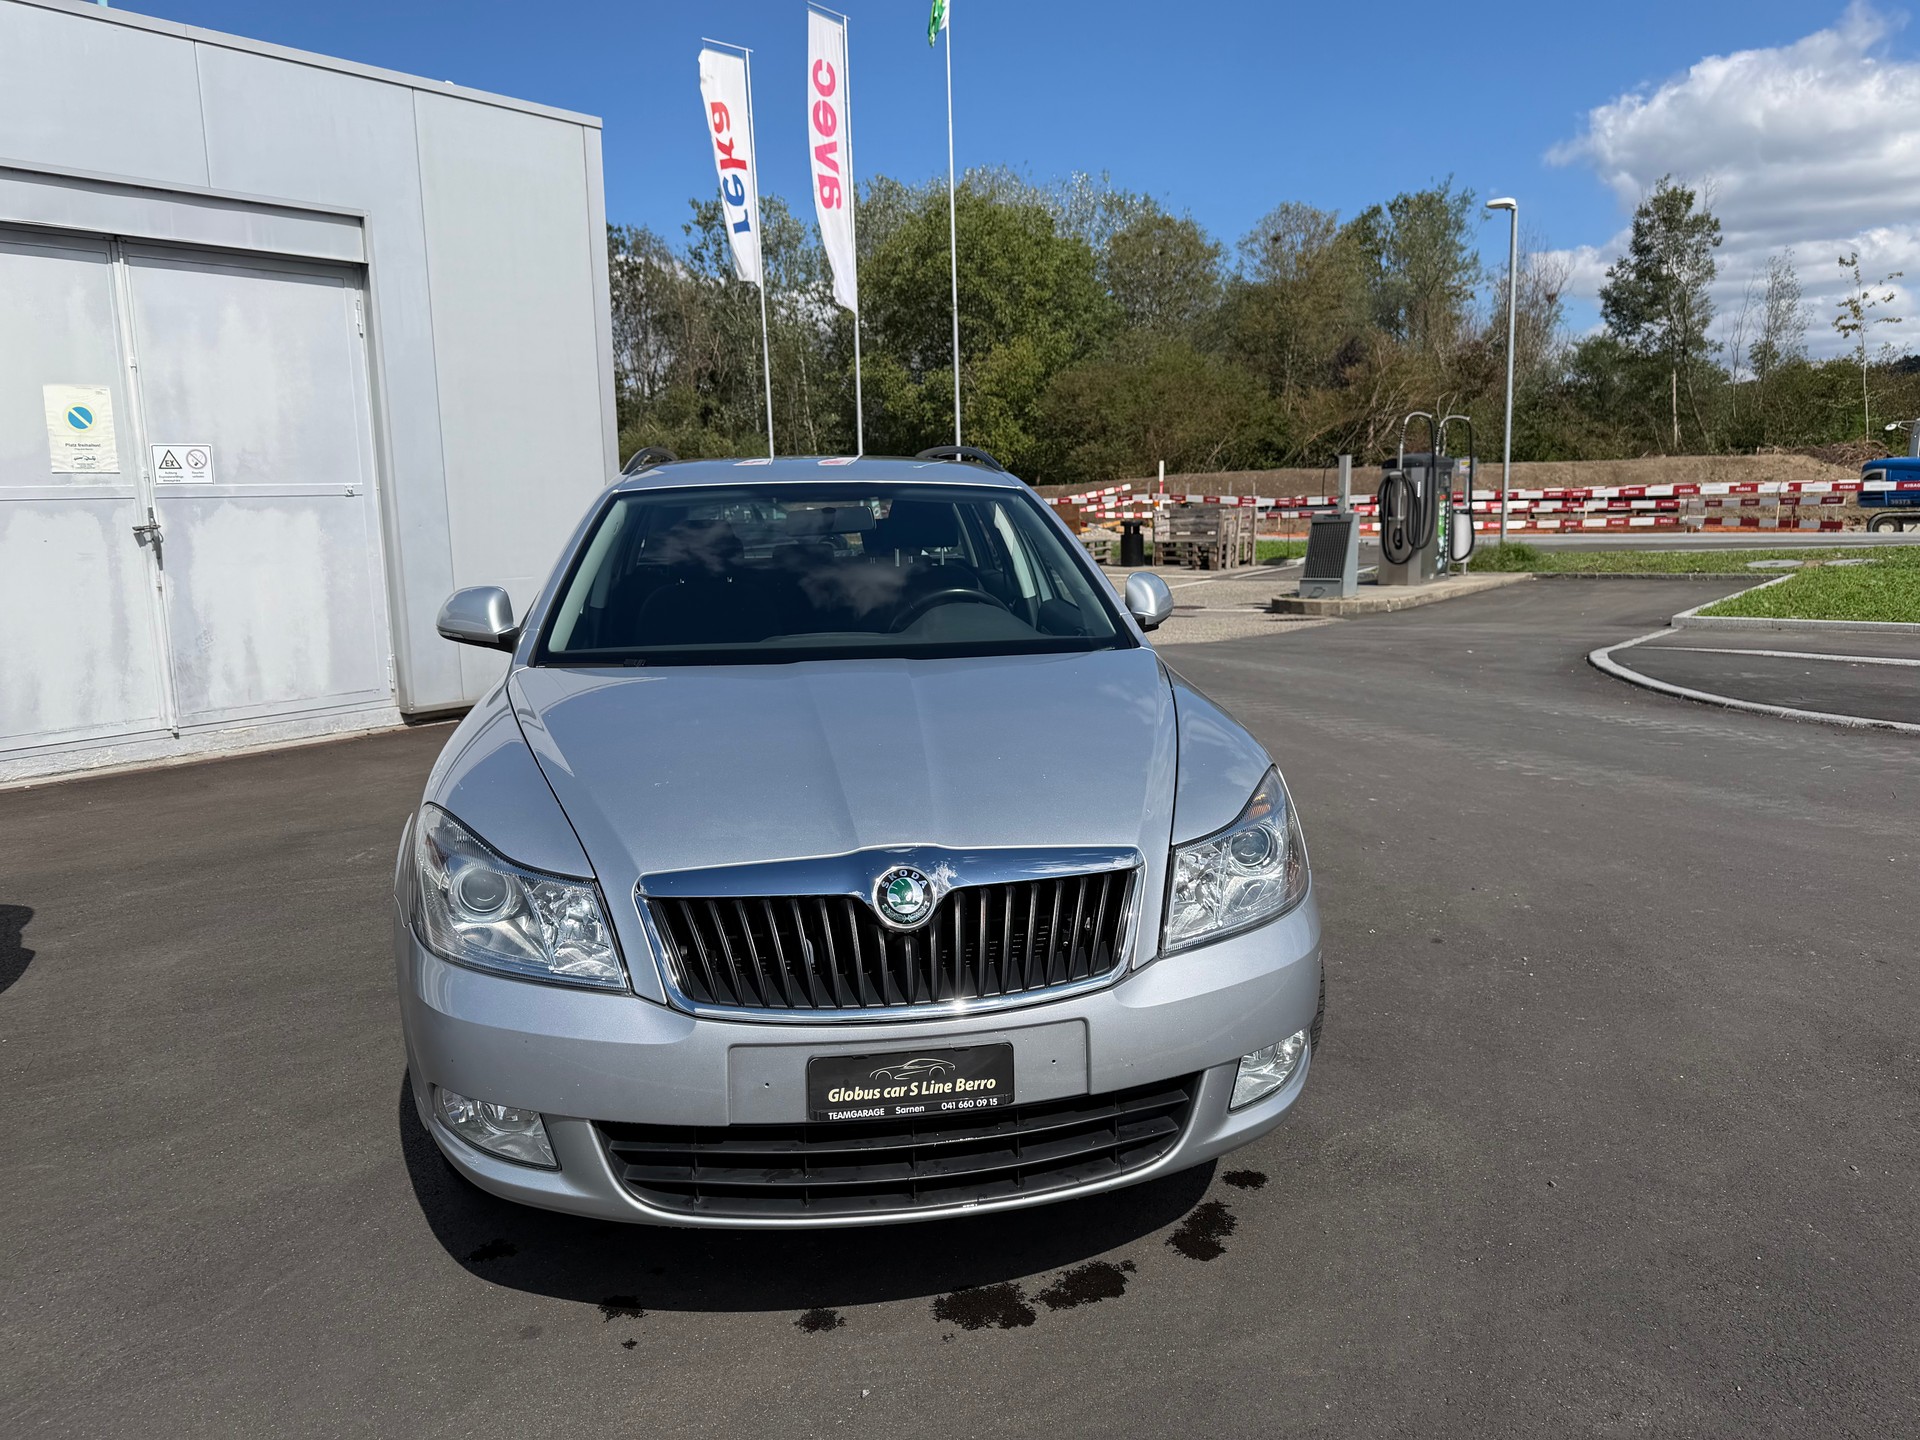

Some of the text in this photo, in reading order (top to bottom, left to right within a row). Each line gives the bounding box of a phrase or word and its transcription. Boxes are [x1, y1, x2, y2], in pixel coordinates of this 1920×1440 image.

[165, 459, 175, 467] EX
[828, 1077, 997, 1103] Globus car S Line Berro
[828, 1097, 998, 1121] TEAMGARAGE Sarnen 041 660 09 15
